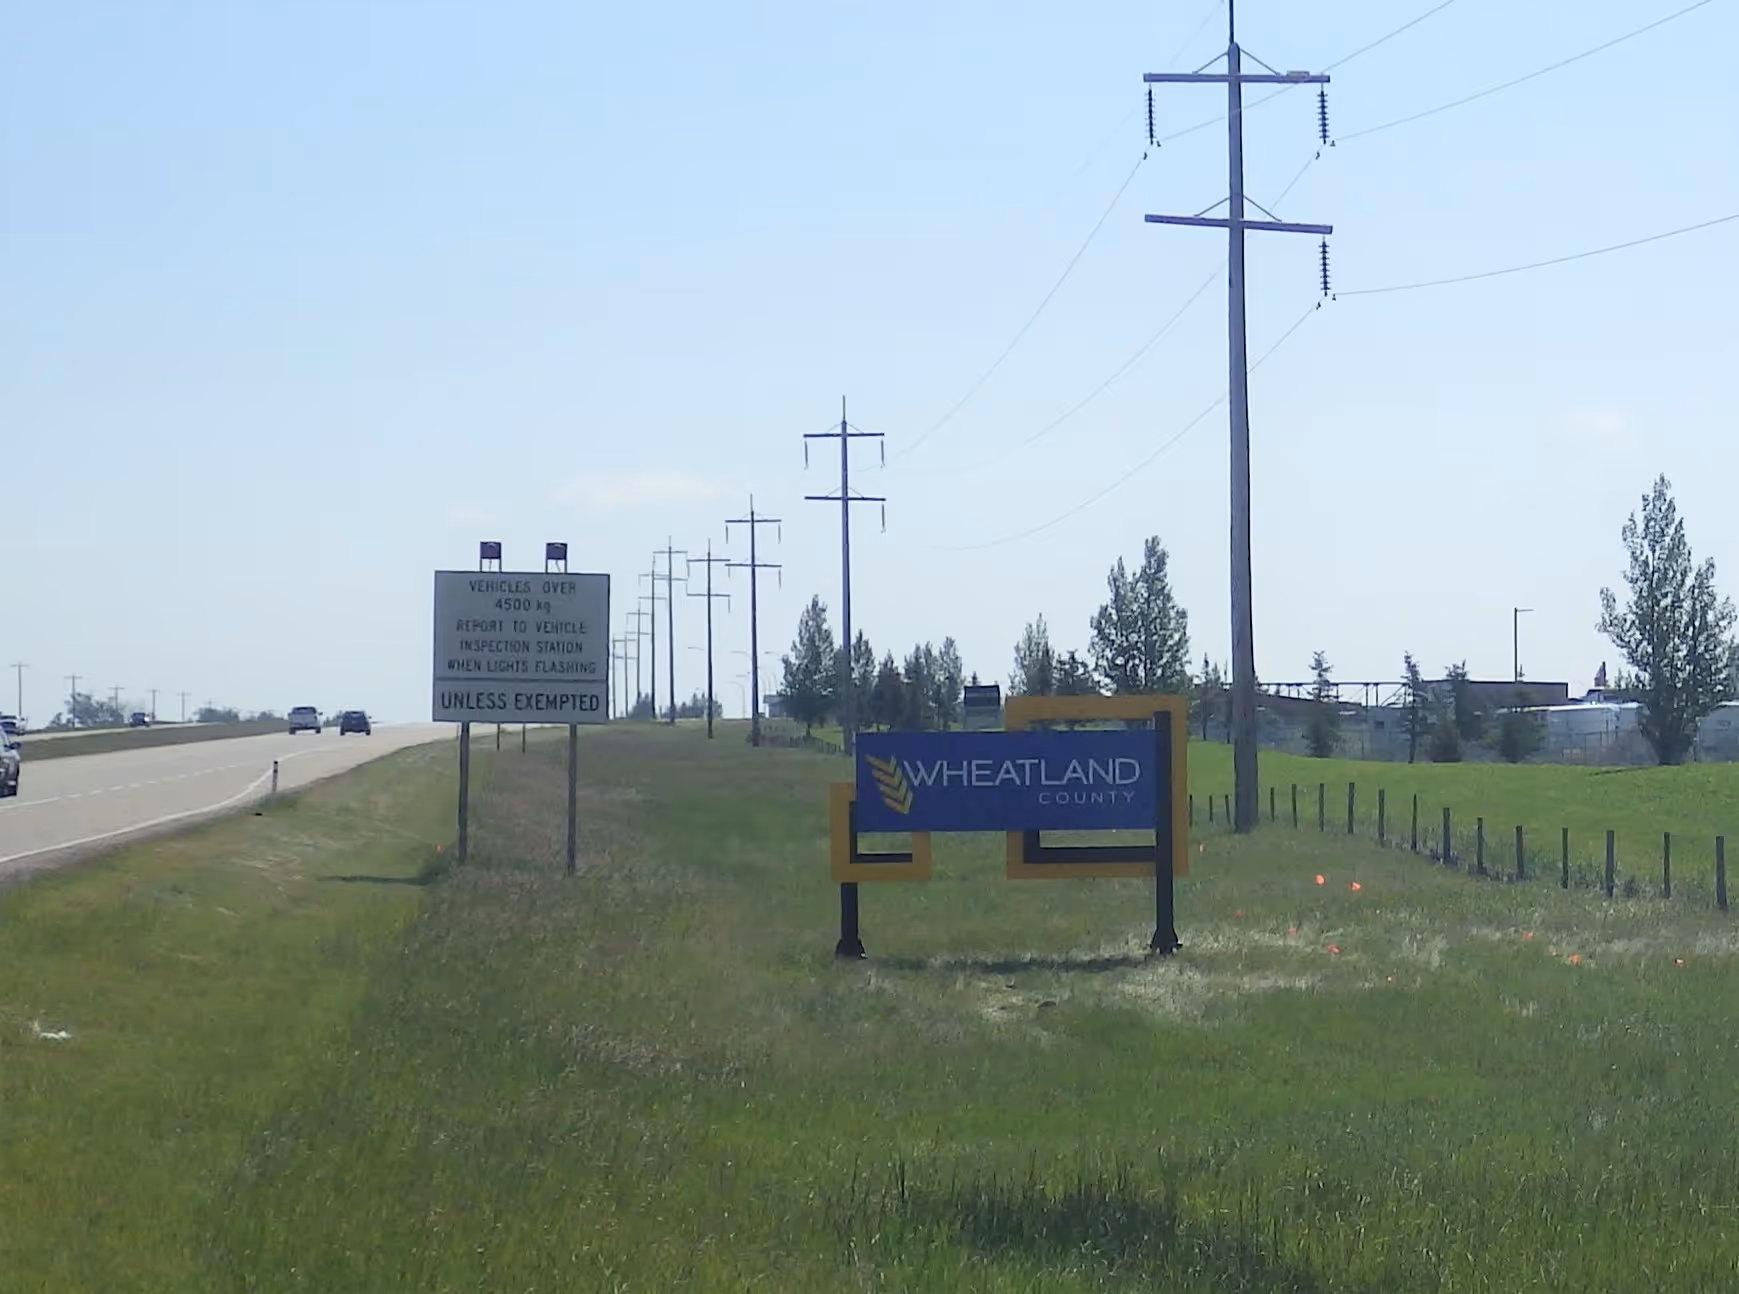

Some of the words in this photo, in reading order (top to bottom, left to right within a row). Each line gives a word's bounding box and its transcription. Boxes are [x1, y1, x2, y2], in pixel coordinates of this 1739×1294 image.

[469, 580, 531, 594] VEHICLES
[542, 581, 576, 594] OVER
[495, 598, 531, 611] 4500
[536, 599, 552, 614] kg
[456, 619, 503, 632] REPORT
[513, 620, 527, 633] TO
[536, 620, 587, 634] VEHICLE
[460, 640, 530, 654] INSPECTION
[536, 640, 583, 654] STATION
[447, 659, 481, 672] WHEN
[487, 660, 528, 673] LIGHTS
[535, 660, 596, 674] FLASHING
[441, 691, 507, 710] UNLESS
[514, 693, 600, 712] EXEMPTED
[903, 757, 1141, 787] WHEATLAND
[1038, 790, 1136, 805] COUNTY
